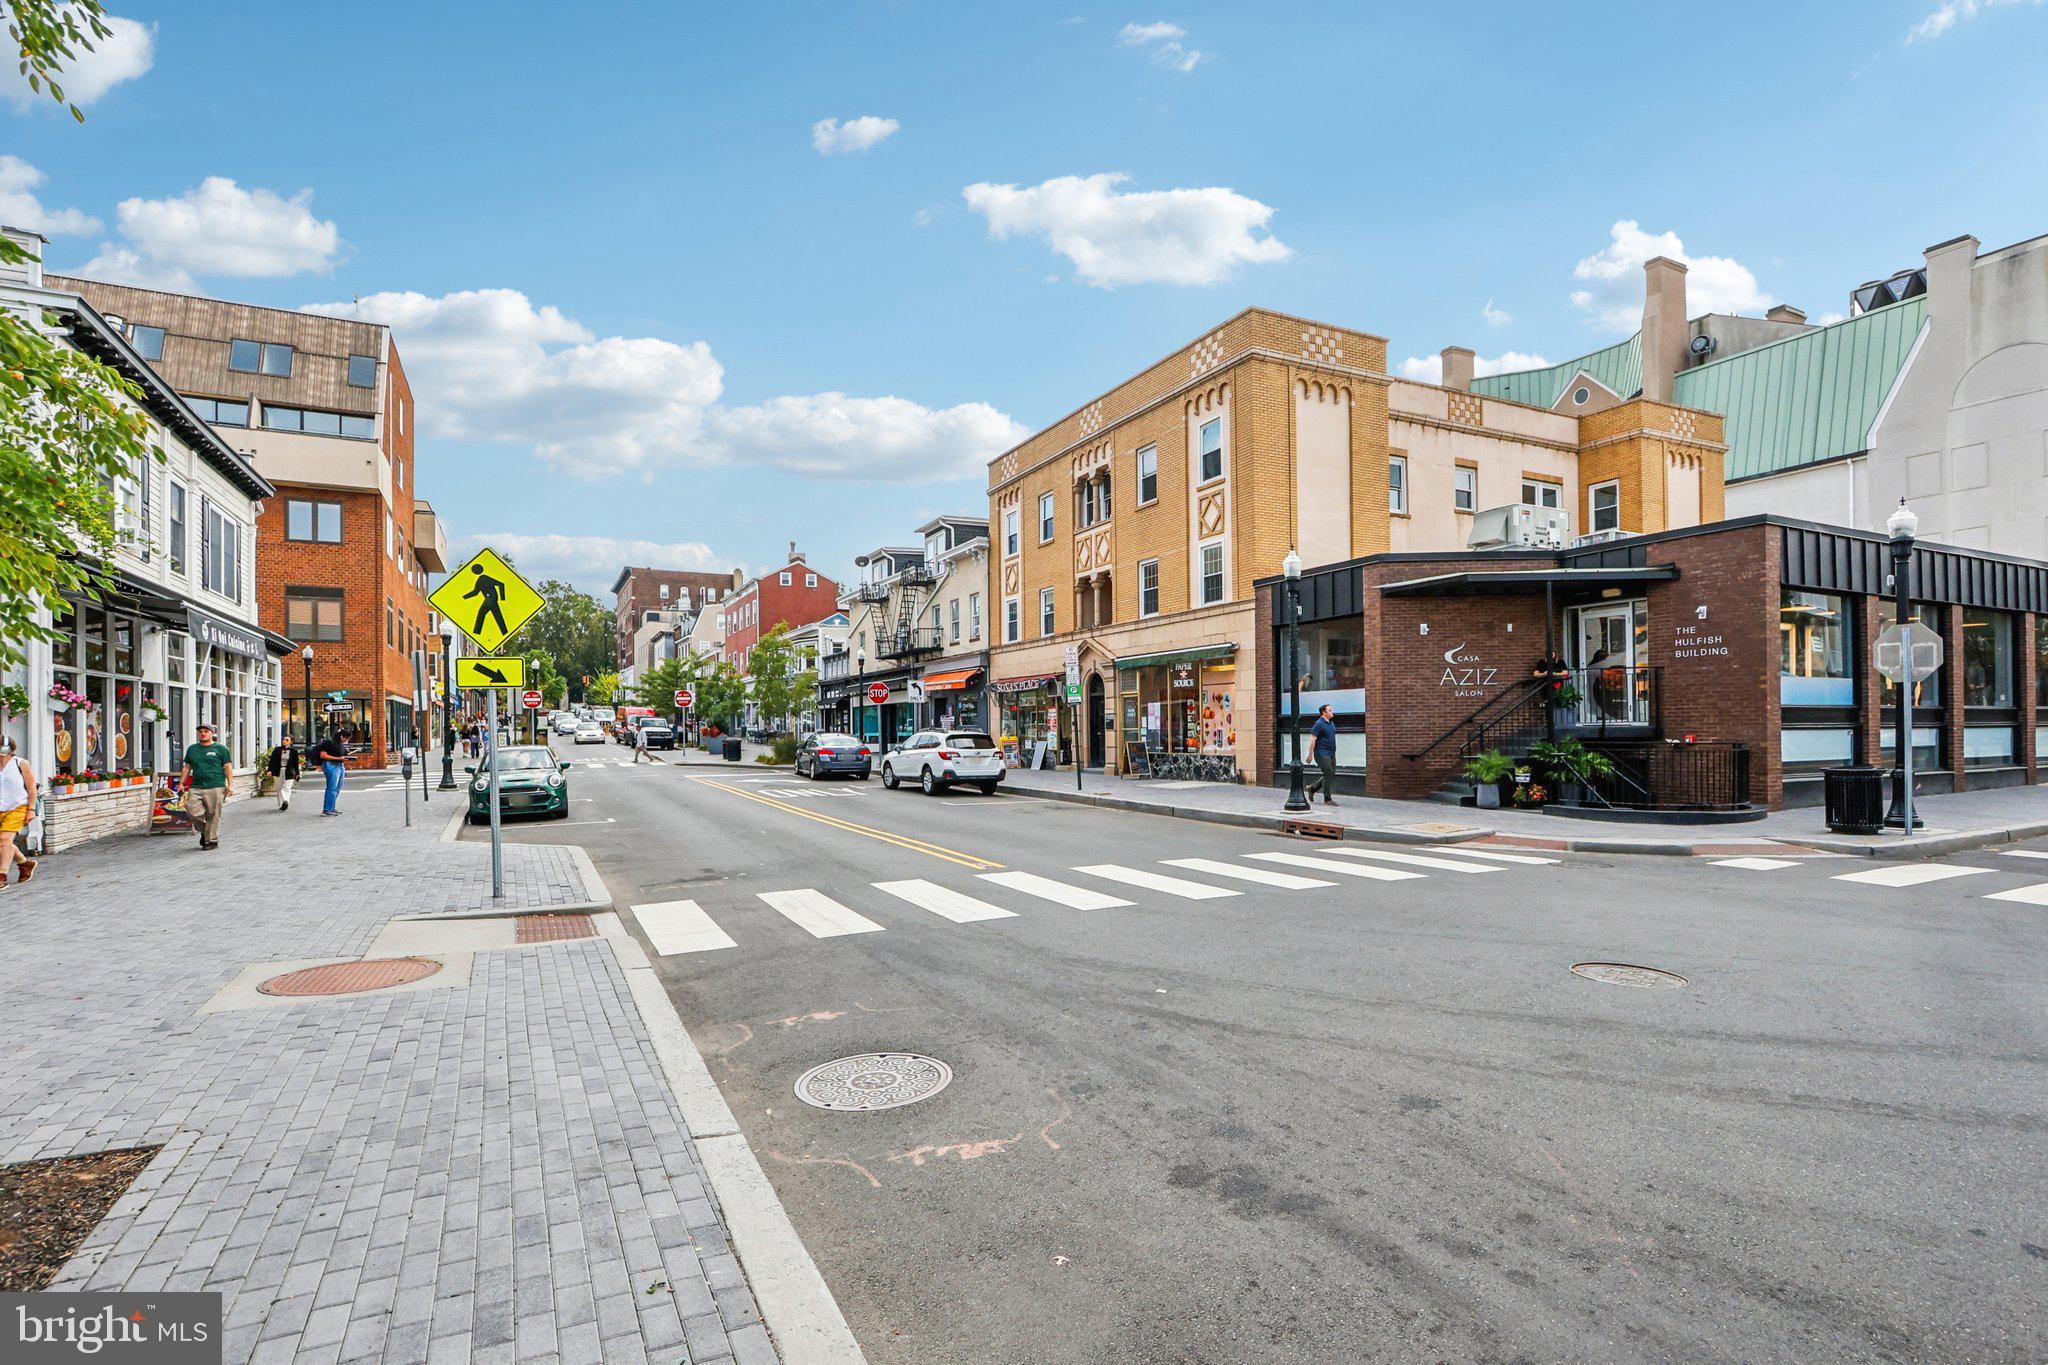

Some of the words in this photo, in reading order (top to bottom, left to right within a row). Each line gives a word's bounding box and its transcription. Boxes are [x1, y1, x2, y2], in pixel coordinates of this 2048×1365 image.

[1675, 626, 1696, 635] THE
[1675, 636, 1722, 646] HULFISH
[1675, 647, 1728, 658] BUILDING
[1175, 662, 1192, 671] PAPER
[1440, 667, 1498, 686] AZIZ
[1020, 680, 1039, 690] PLACE
[1173, 679, 1195, 688] SOURCE
[869, 689, 888, 698] STOP
[757, 785, 868, 798] ONLY
